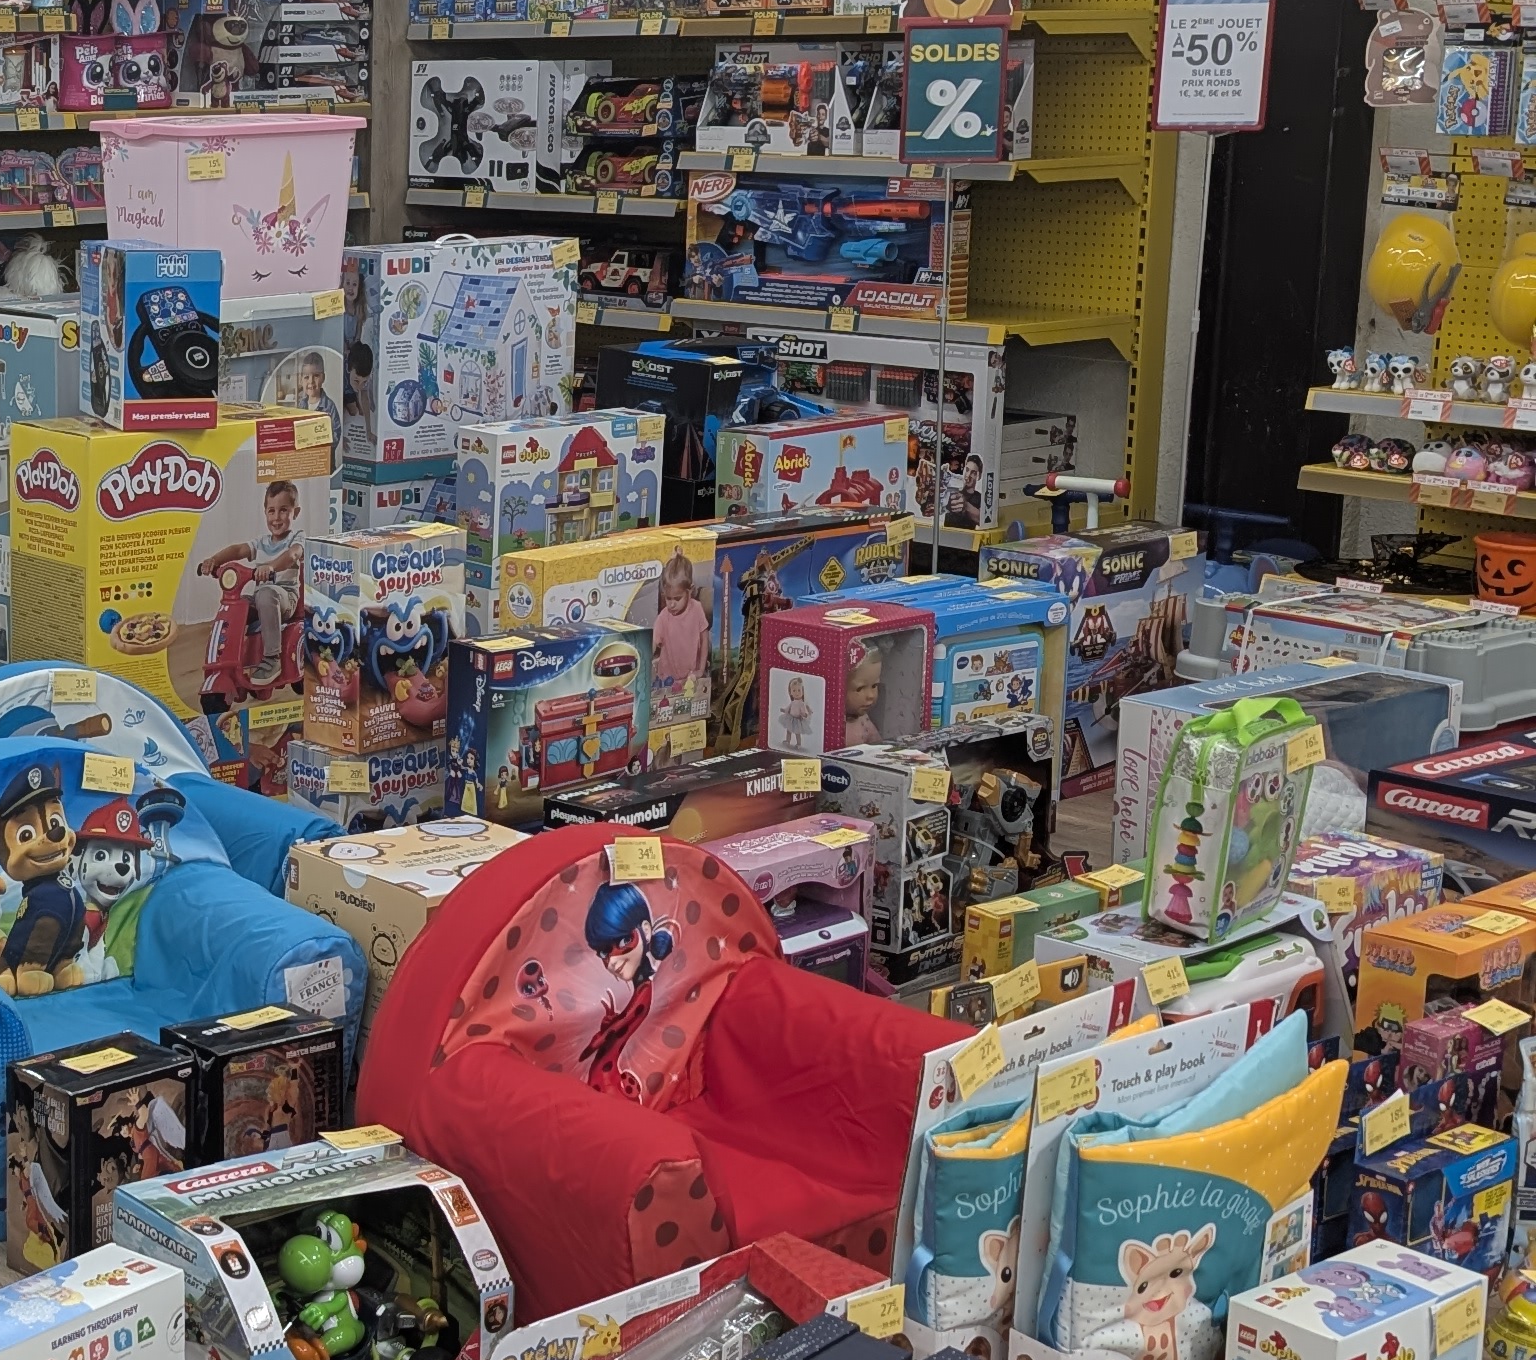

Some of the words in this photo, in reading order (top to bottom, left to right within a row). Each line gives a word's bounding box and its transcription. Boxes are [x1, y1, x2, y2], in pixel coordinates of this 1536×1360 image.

[1171, 19, 1186, 29] LE
[1218, 18, 1262, 28] JOUET
[691, 175, 734, 199] NERF
[857, 290, 937, 306] LOADOUT
[132, 412, 149, 421] Mon
[151, 412, 184, 421] premier
[186, 411, 210, 420] volant
[775, 453, 810, 472] Abrick
[17, 460, 77, 504] Play-Doh
[987, 558, 1039, 578] SONIC
[1412, 744, 1525, 777] Carrera
[551, 808, 595, 825] playmobil
[1385, 788, 1482, 824] Carrera
[1111, 1070, 1141, 1092] Touch
[1154, 1063, 1178, 1079] play
[1180, 1055, 1206, 1072] book
[1097, 1181, 1196, 1226] Sophie
[1199, 1180, 1225, 1209] la
